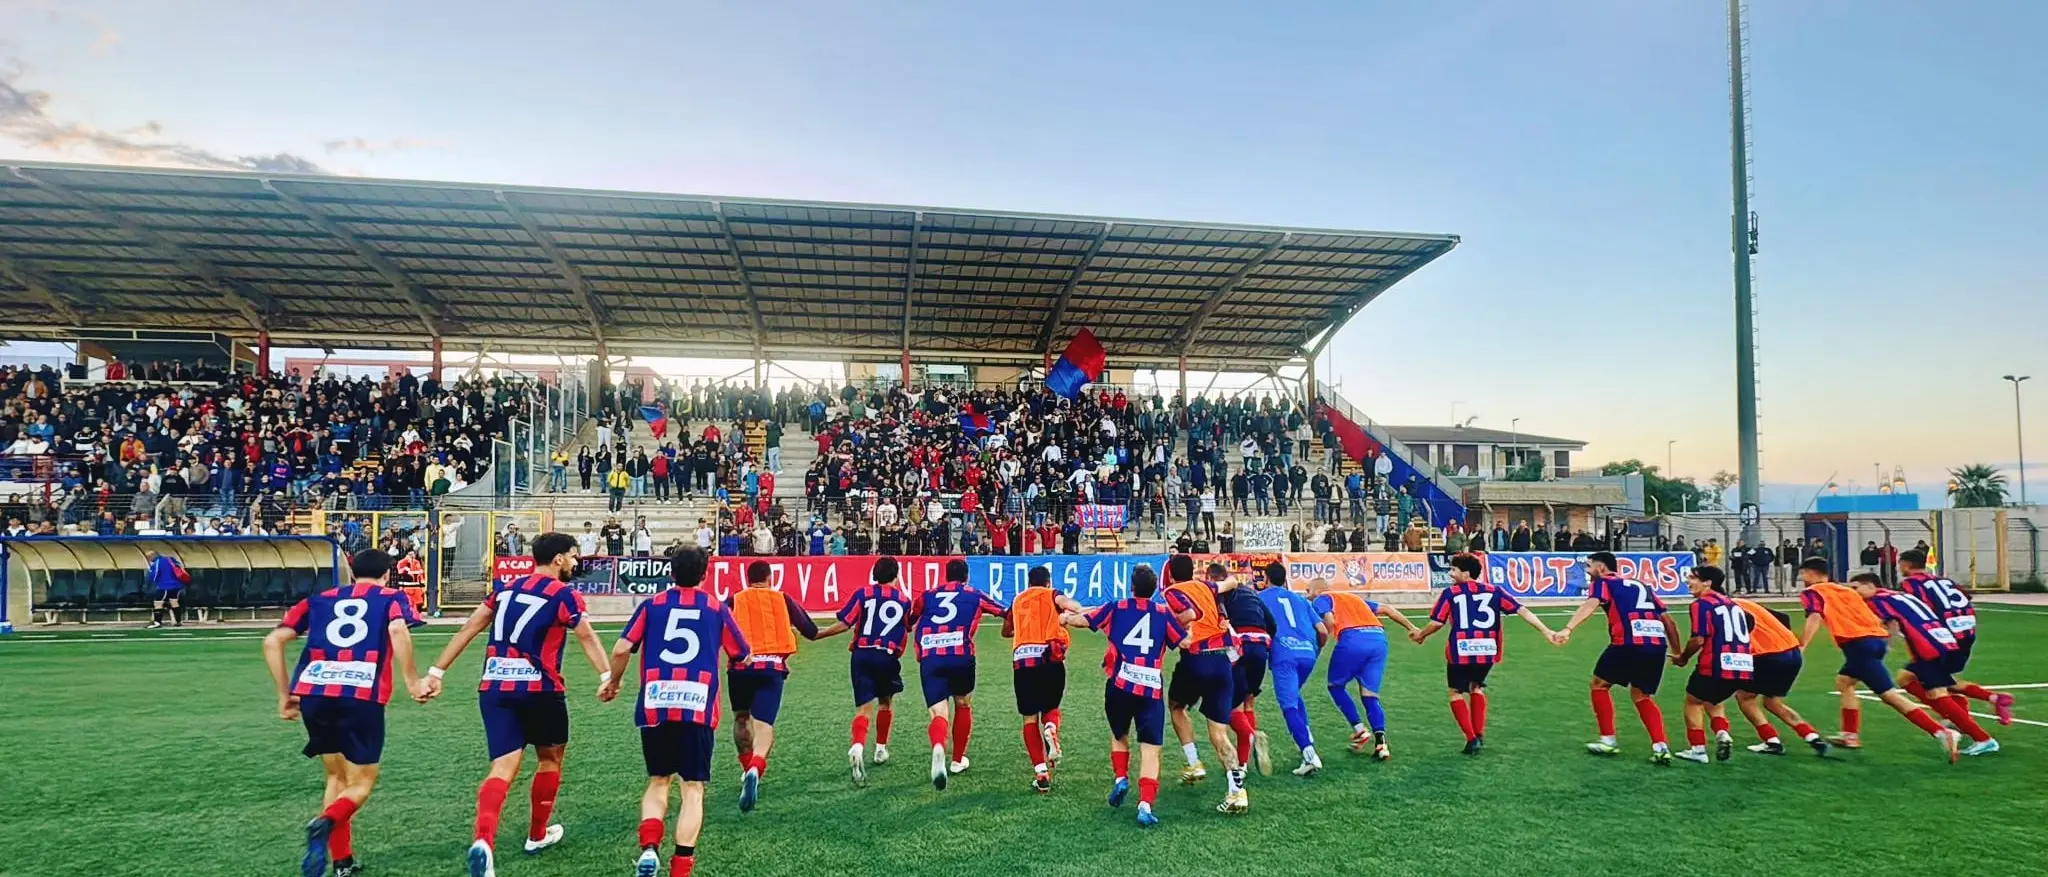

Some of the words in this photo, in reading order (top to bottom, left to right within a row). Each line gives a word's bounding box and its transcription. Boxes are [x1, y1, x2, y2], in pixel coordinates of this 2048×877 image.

[619, 559, 672, 576] DIFFIDA
[869, 562, 939, 601] UD
[989, 561, 1151, 600] ROSAN
[1289, 563, 1337, 579] BOYS
[1372, 562, 1425, 581] ROSSANO
[627, 582, 657, 594] CON
[1623, 579, 1656, 610] 2
[1923, 579, 1969, 609] 15
[325, 598, 369, 648] 8
[494, 590, 549, 644] 17
[863, 599, 904, 637] 19
[930, 592, 960, 624] 3
[1277, 597, 1297, 628] 1
[1453, 592, 1496, 629] 13
[1891, 593, 1939, 621] 11
[659, 608, 701, 665] 5
[1122, 612, 1154, 655] 4
[1714, 605, 1750, 644] 10
[659, 691, 706, 703] CETERA
